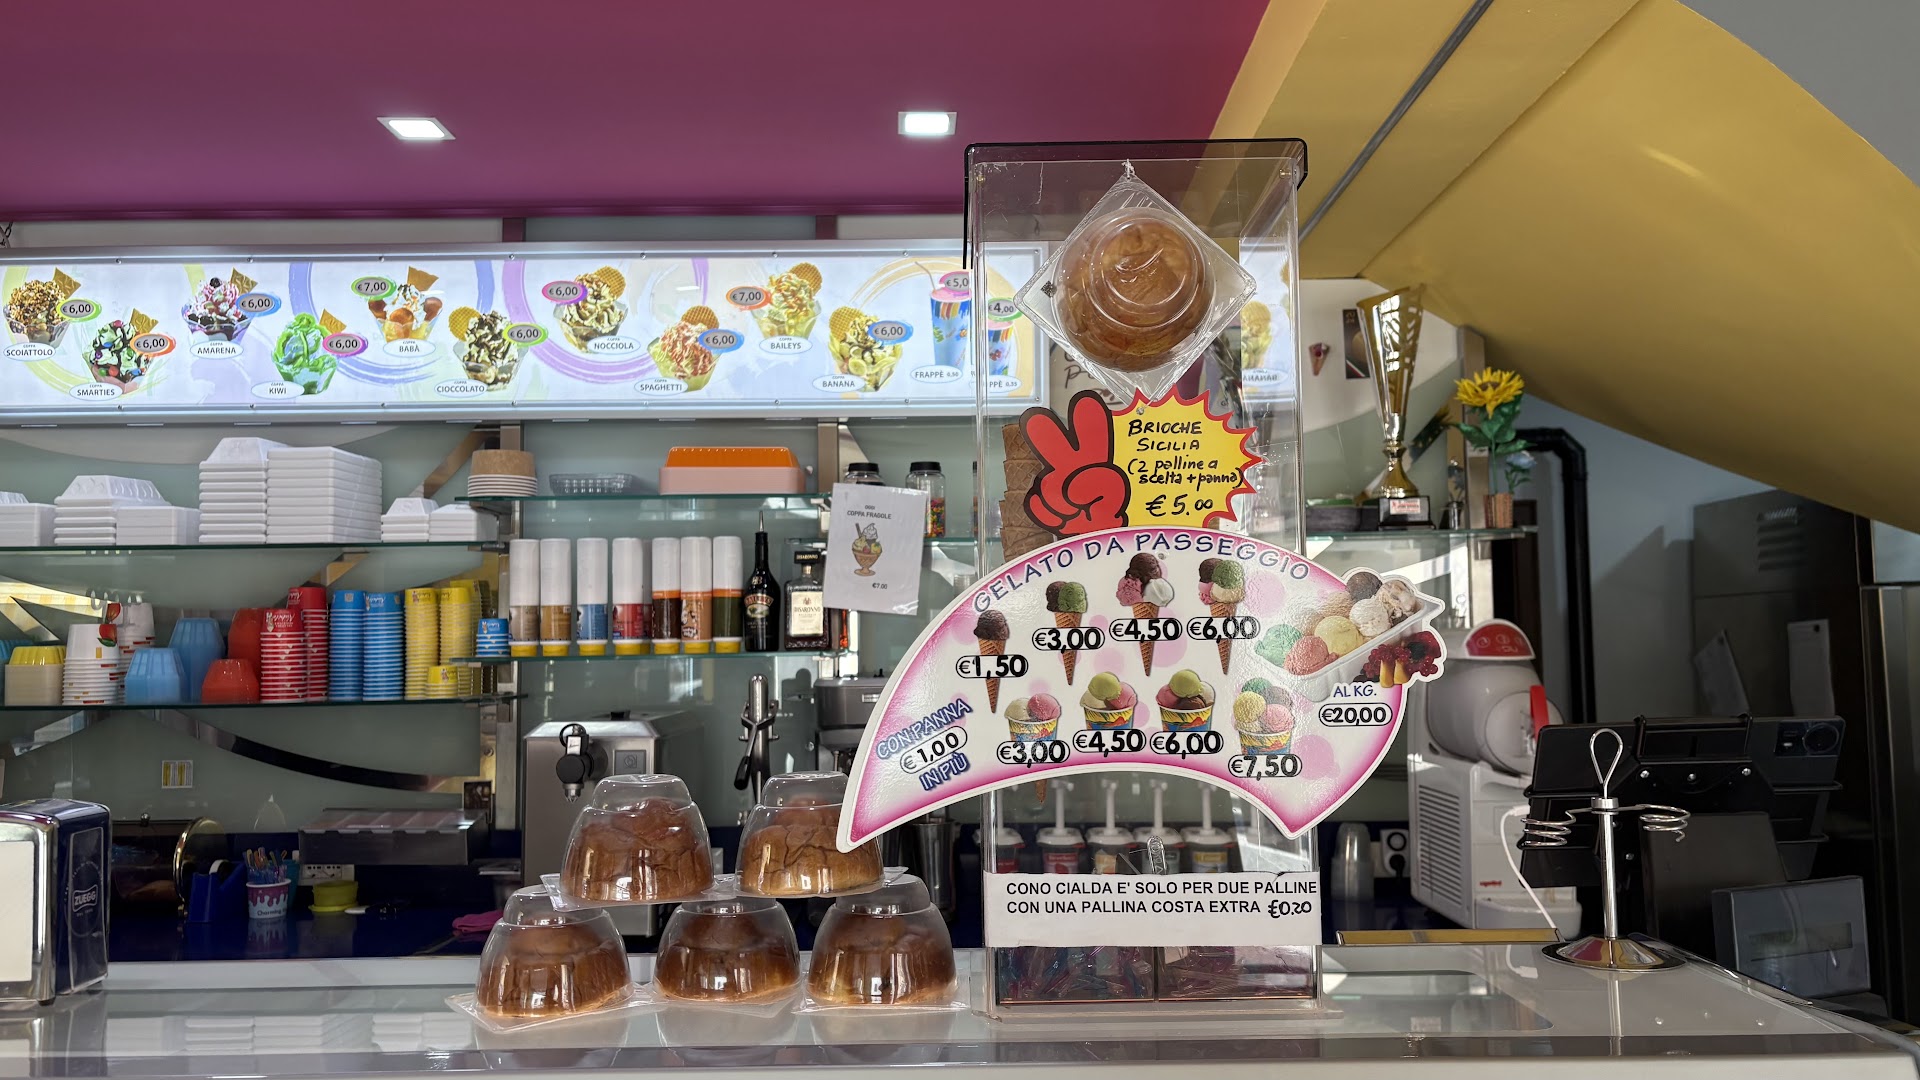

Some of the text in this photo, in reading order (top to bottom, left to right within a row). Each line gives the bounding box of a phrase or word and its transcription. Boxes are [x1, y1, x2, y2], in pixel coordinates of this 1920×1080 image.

[6, 349, 53, 357] SCOIATTOLO
[196, 346, 238, 355] AMARENA
[398, 344, 420, 353] BABÀ
[593, 342, 635, 351] NOCCIOLA
[769, 341, 803, 351] BAILEYS
[914, 369, 945, 379] FRAPPÈ
[268, 387, 287, 395] KIWI
[436, 385, 485, 394] CIOCCOLATO
[639, 383, 683, 393] SPAGHETTI
[821, 380, 856, 389] BANANA
[76, 388, 116, 397] SMARTIES
[1128, 418, 1203, 437] BRIOCHE
[1136, 437, 1200, 452] SICILIA
[1153, 454, 1204, 477] palline
[1208, 459, 1219, 470] a
[1138, 471, 1183, 485] scelta
[846, 509, 892, 520] COPPA FRAGOLE
[974, 532, 1310, 613] GELATO DA PASSEGGIO
[1111, 618, 1181, 643] €4,50
[1189, 616, 1258, 643] €6,00
[1034, 627, 1101, 654] €3,00
[958, 654, 1027, 680] €1,50
[1333, 684, 1377, 698] AL KG.
[1321, 706, 1387, 726] €20,00
[876, 698, 973, 760] CON PANNA
[1075, 730, 1145, 758] €4,50
[1151, 730, 1223, 760] €6,00
[999, 740, 1067, 768] €3,00
[918, 751, 971, 791] IN PIÙ
[1230, 754, 1299, 781] €7,50
[1006, 881, 1317, 895] CONO CIALDA E' SOLO PER DUE PALLINE
[74, 890, 97, 906] ZUEGG
[1006, 901, 1040, 914] CON
[1044, 901, 1077, 914] UNA
[1081, 900, 1147, 913] PALLINA
[1151, 900, 1205, 913] COSTA
[1209, 900, 1261, 913] EXTRA
